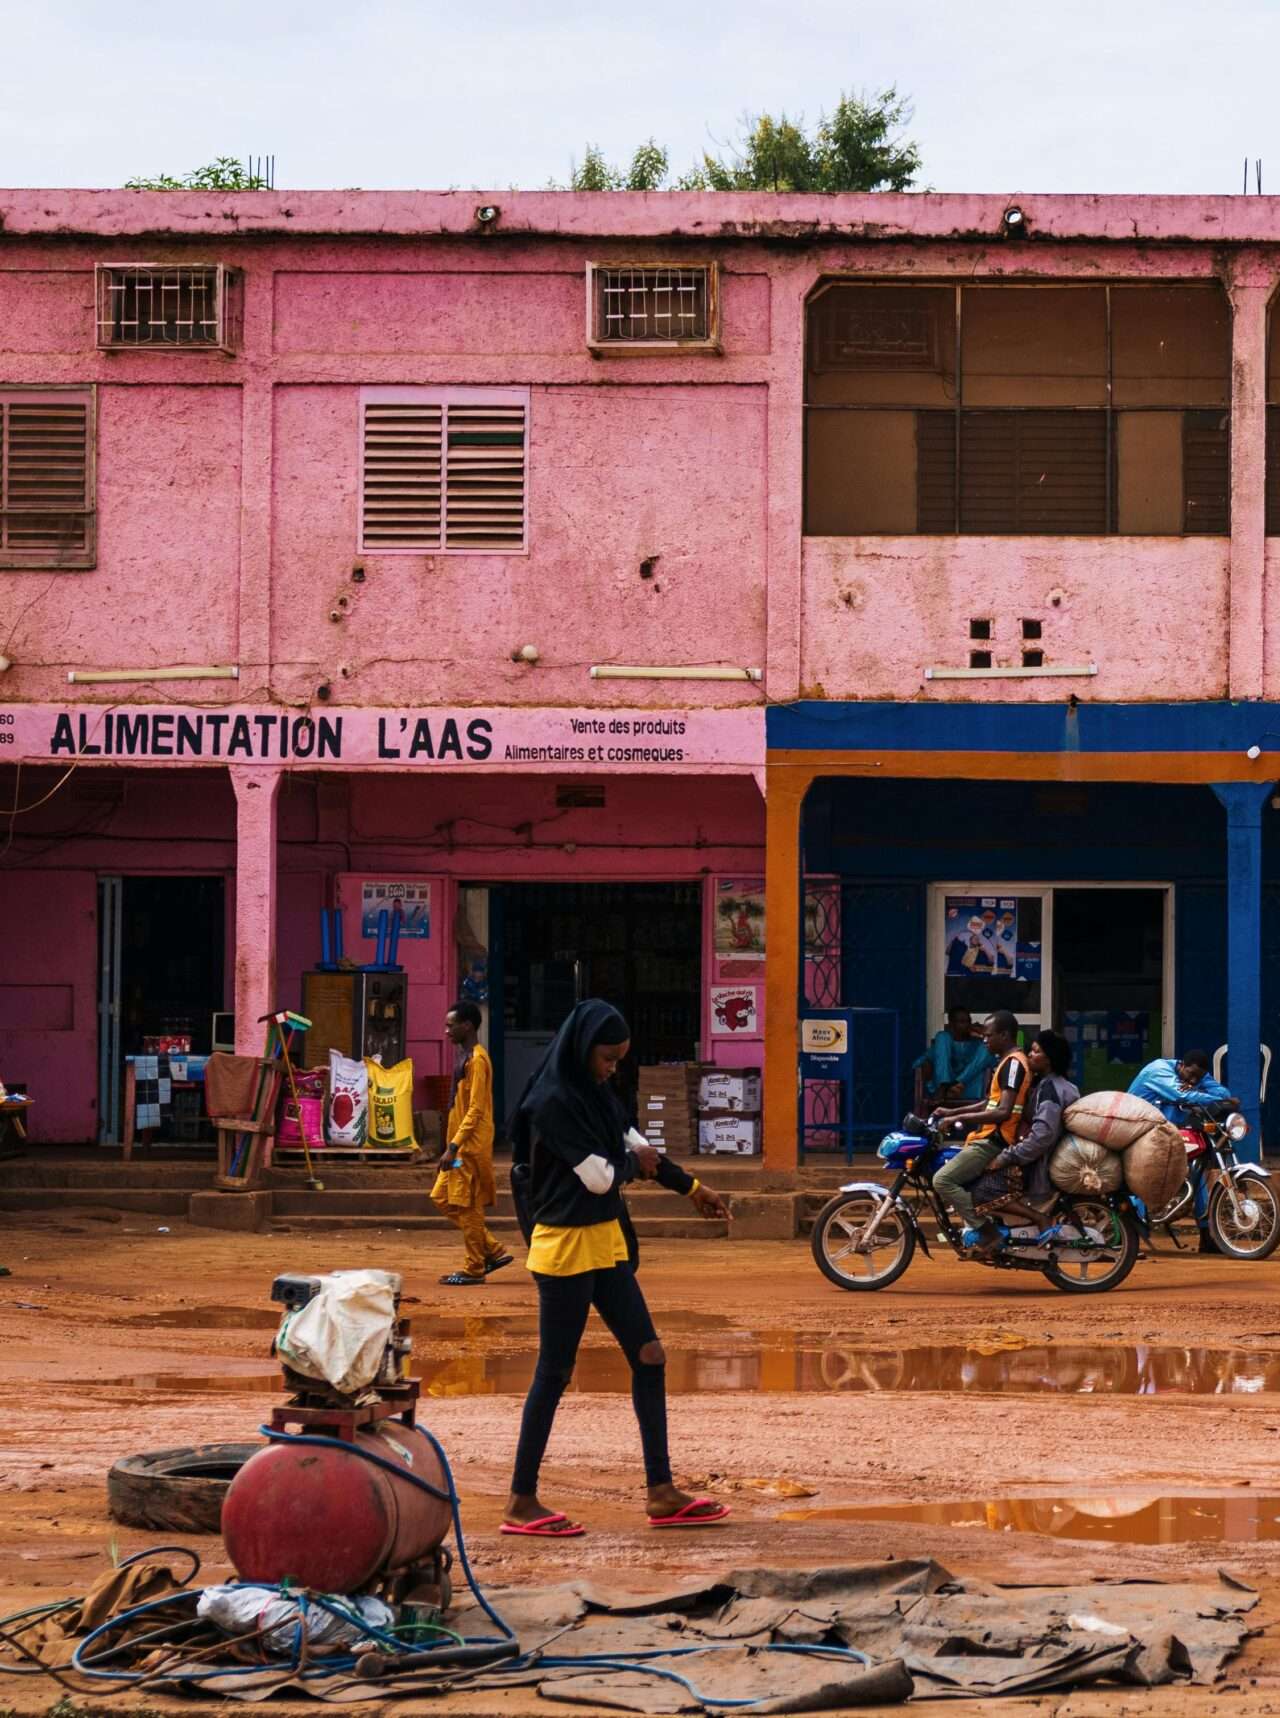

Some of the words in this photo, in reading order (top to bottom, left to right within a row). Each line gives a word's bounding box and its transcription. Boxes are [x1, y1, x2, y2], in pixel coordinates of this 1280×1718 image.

[570, 718, 606, 734] Vente
[608, 719, 630, 734] des
[633, 719, 686, 736] produits
[50, 713, 343, 759] ALIMENTATION
[377, 717, 493, 760] L'AAS
[504, 744, 585, 760] Alimentaires
[587, 746, 604, 761] et
